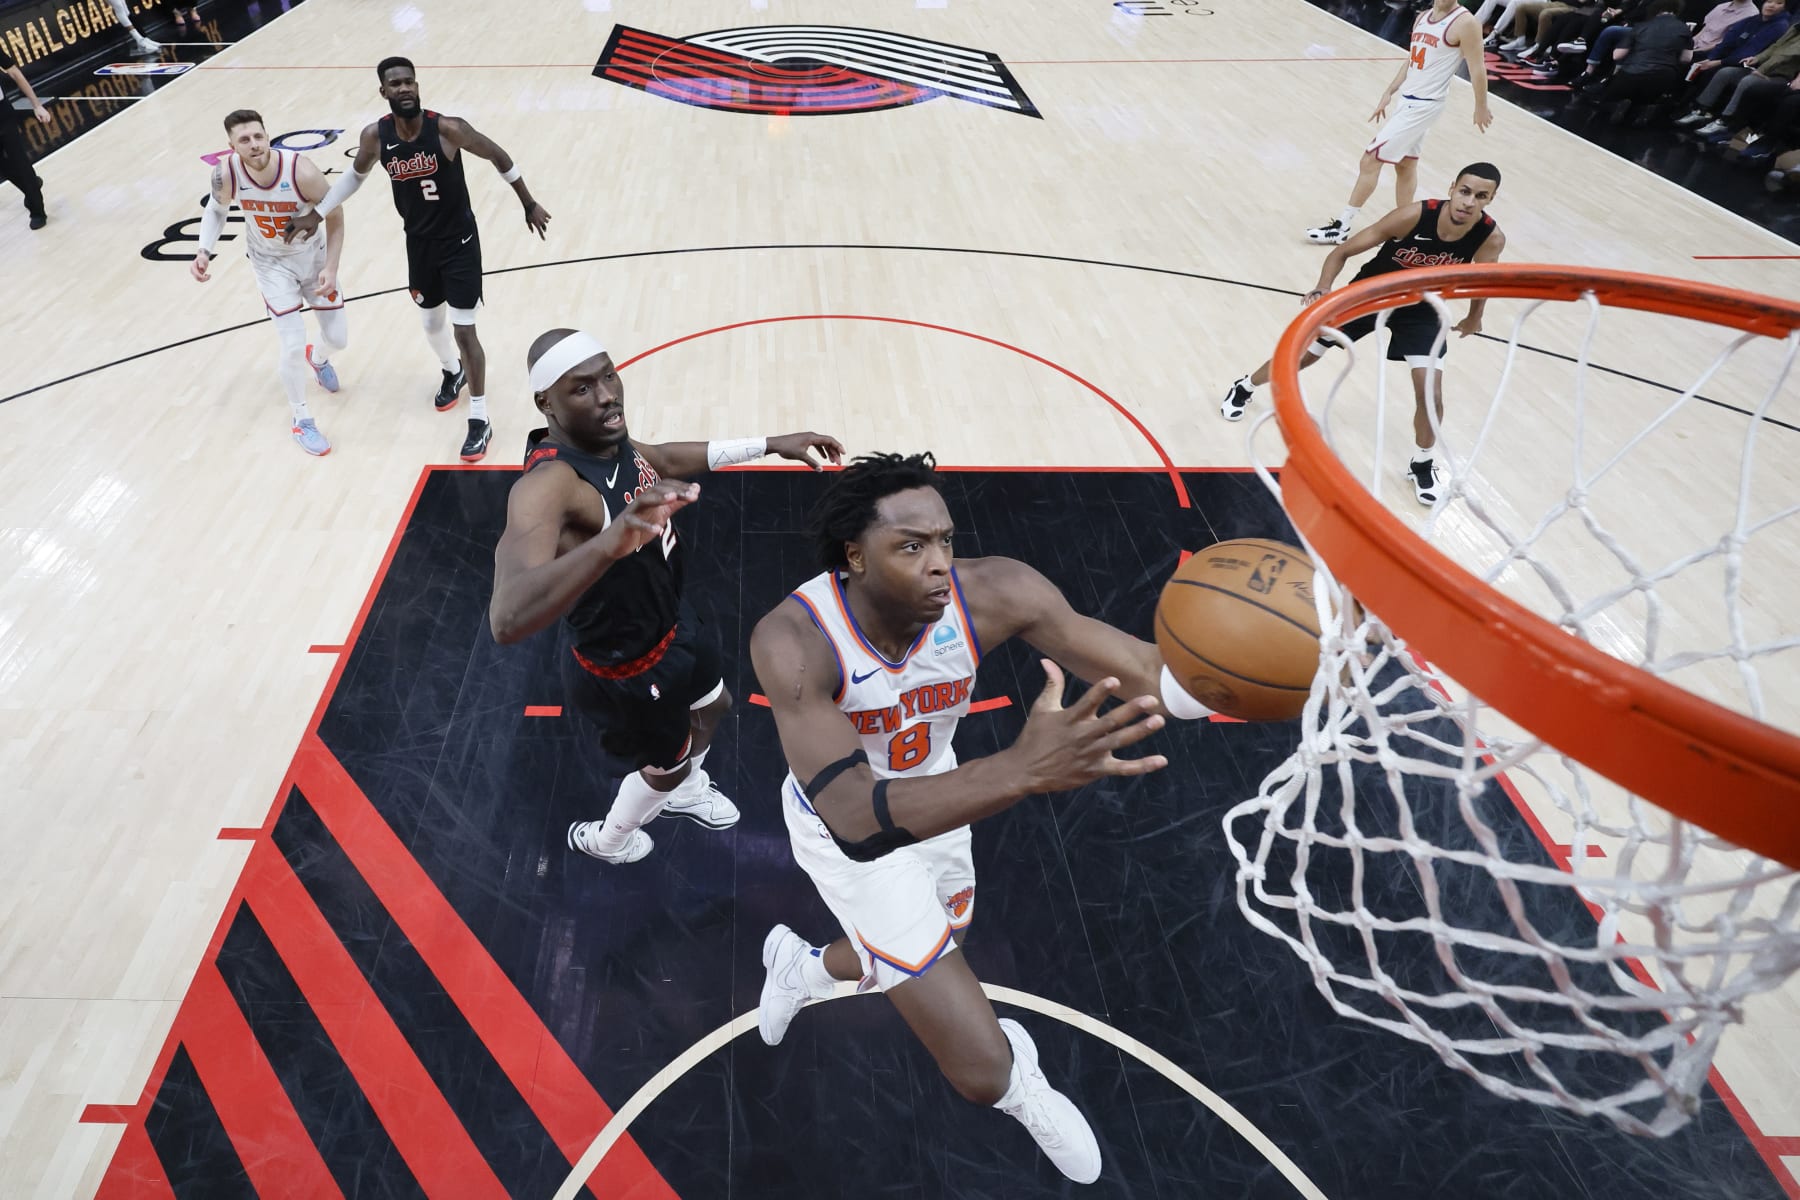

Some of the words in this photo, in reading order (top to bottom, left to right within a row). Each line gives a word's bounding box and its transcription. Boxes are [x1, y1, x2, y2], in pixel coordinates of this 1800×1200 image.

[420, 179, 440, 200] 2
[253, 215, 291, 239] 55
[934, 641, 965, 658] sphere
[900, 676, 972, 720] YORK
[887, 721, 932, 773] 8
